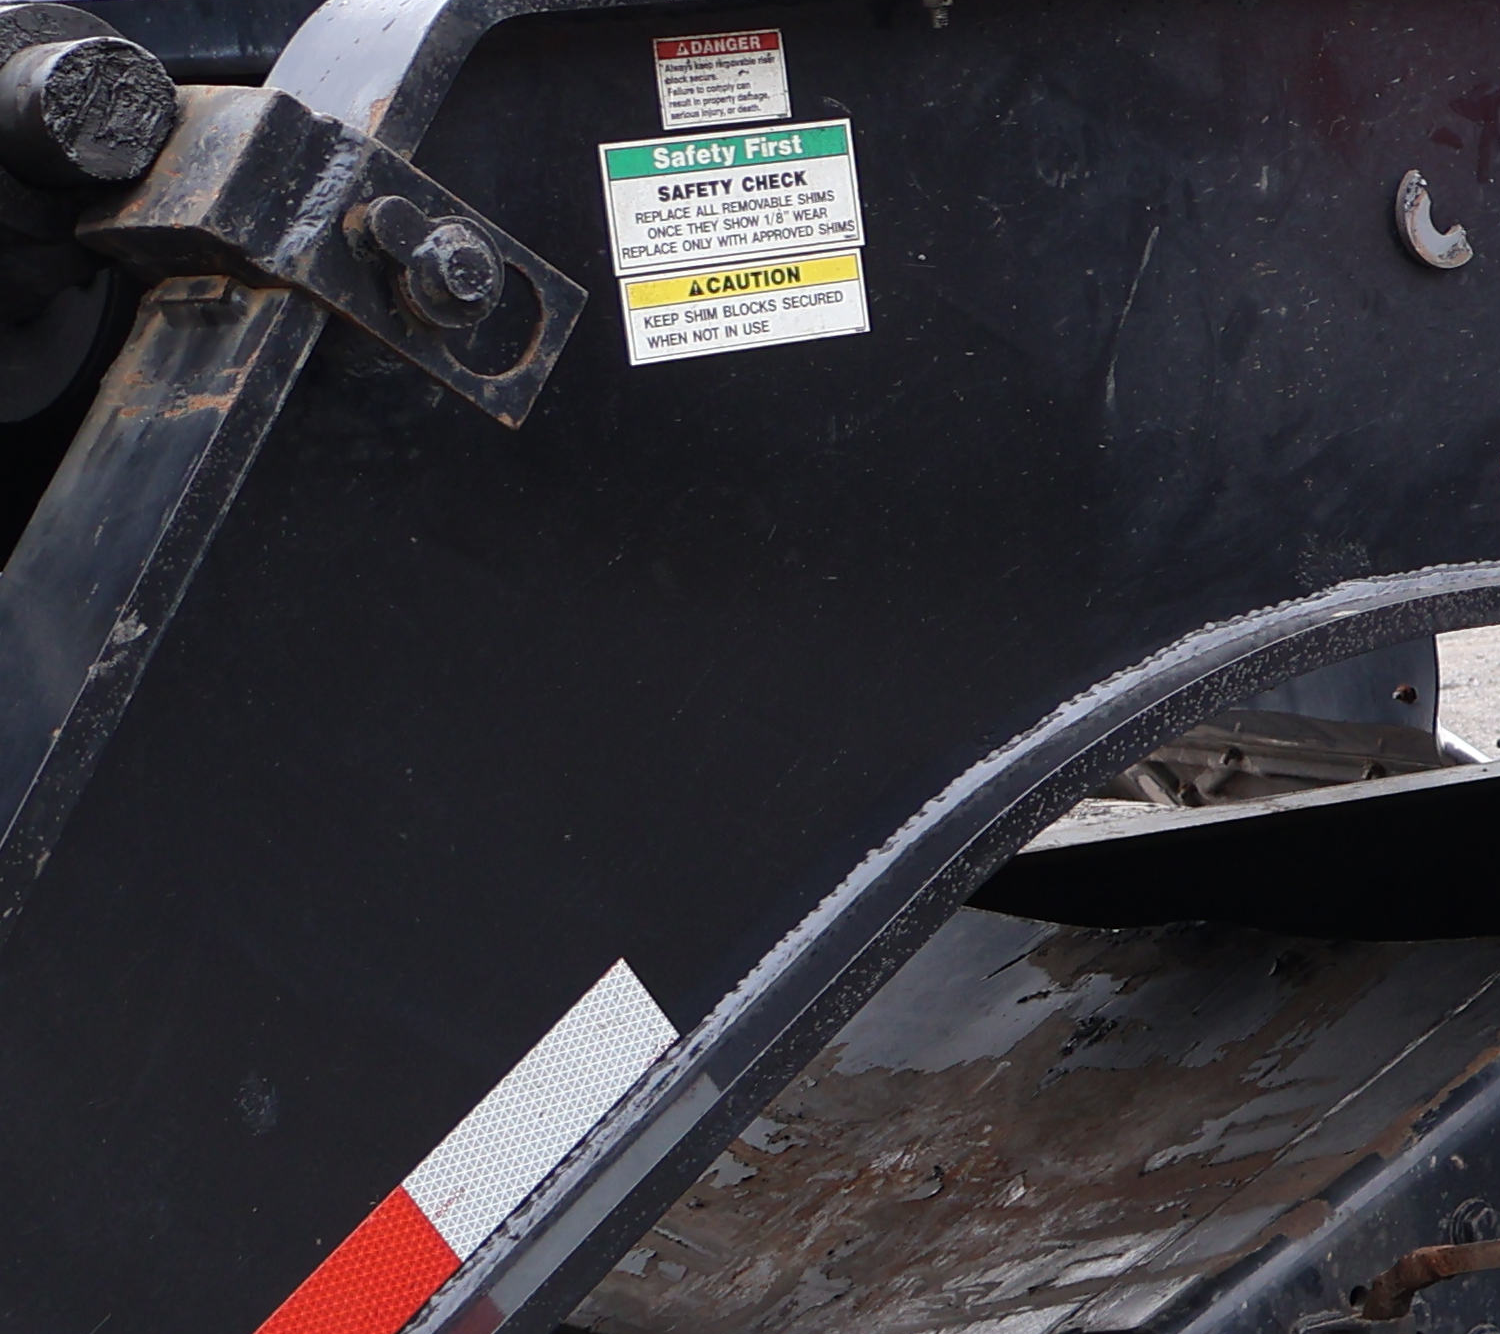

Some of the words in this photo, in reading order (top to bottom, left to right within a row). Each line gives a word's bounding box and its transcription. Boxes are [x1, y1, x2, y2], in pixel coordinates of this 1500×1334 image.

[691, 36, 761, 55] DANGER
[664, 75, 689, 85] block
[690, 73, 719, 83] secure.
[665, 61, 693, 74] Always
[694, 60, 714, 70] keep
[715, 57, 757, 69] removable
[758, 56, 775, 65] riser
[667, 86, 695, 97] Failure
[696, 85, 705, 94] to
[706, 83, 735, 95] comply
[736, 82, 752, 90] can
[669, 97, 692, 108] result
[693, 96, 701, 106] in
[703, 94, 735, 107] property
[671, 110, 699, 120] serious
[727, 106, 736, 114] or
[737, 103, 761, 113] death.
[653, 143, 735, 170] Safety
[744, 135, 803, 160] First
[658, 179, 733, 202] SAFETY
[741, 170, 808, 193] CHECK
[635, 206, 691, 225] REPLACE
[695, 202, 719, 217] ALL
[722, 196, 793, 214] REMOVABLE
[797, 189, 835, 204] SHIMS
[648, 225, 683, 240] ONCE
[686, 220, 719, 235] THEY
[723, 215, 760, 231] SHOW
[792, 207, 828, 222] WEAR
[622, 242, 677, 260] REPLACE
[682, 237, 713, 252] ONLY
[718, 233, 748, 248] WITH
[752, 226, 814, 244] APPROVED
[818, 220, 856, 235] SHIMS
[706, 265, 801, 294] CAUTION
[643, 313, 680, 329] KEEP
[684, 307, 718, 324] SHIM
[723, 299, 777, 318] BLOCKS
[782, 290, 844, 310] SECURED
[647, 332, 688, 349] WHEN
[693, 327, 720, 343] NOT
[725, 325, 738, 338] IN
[742, 320, 771, 335] USE
